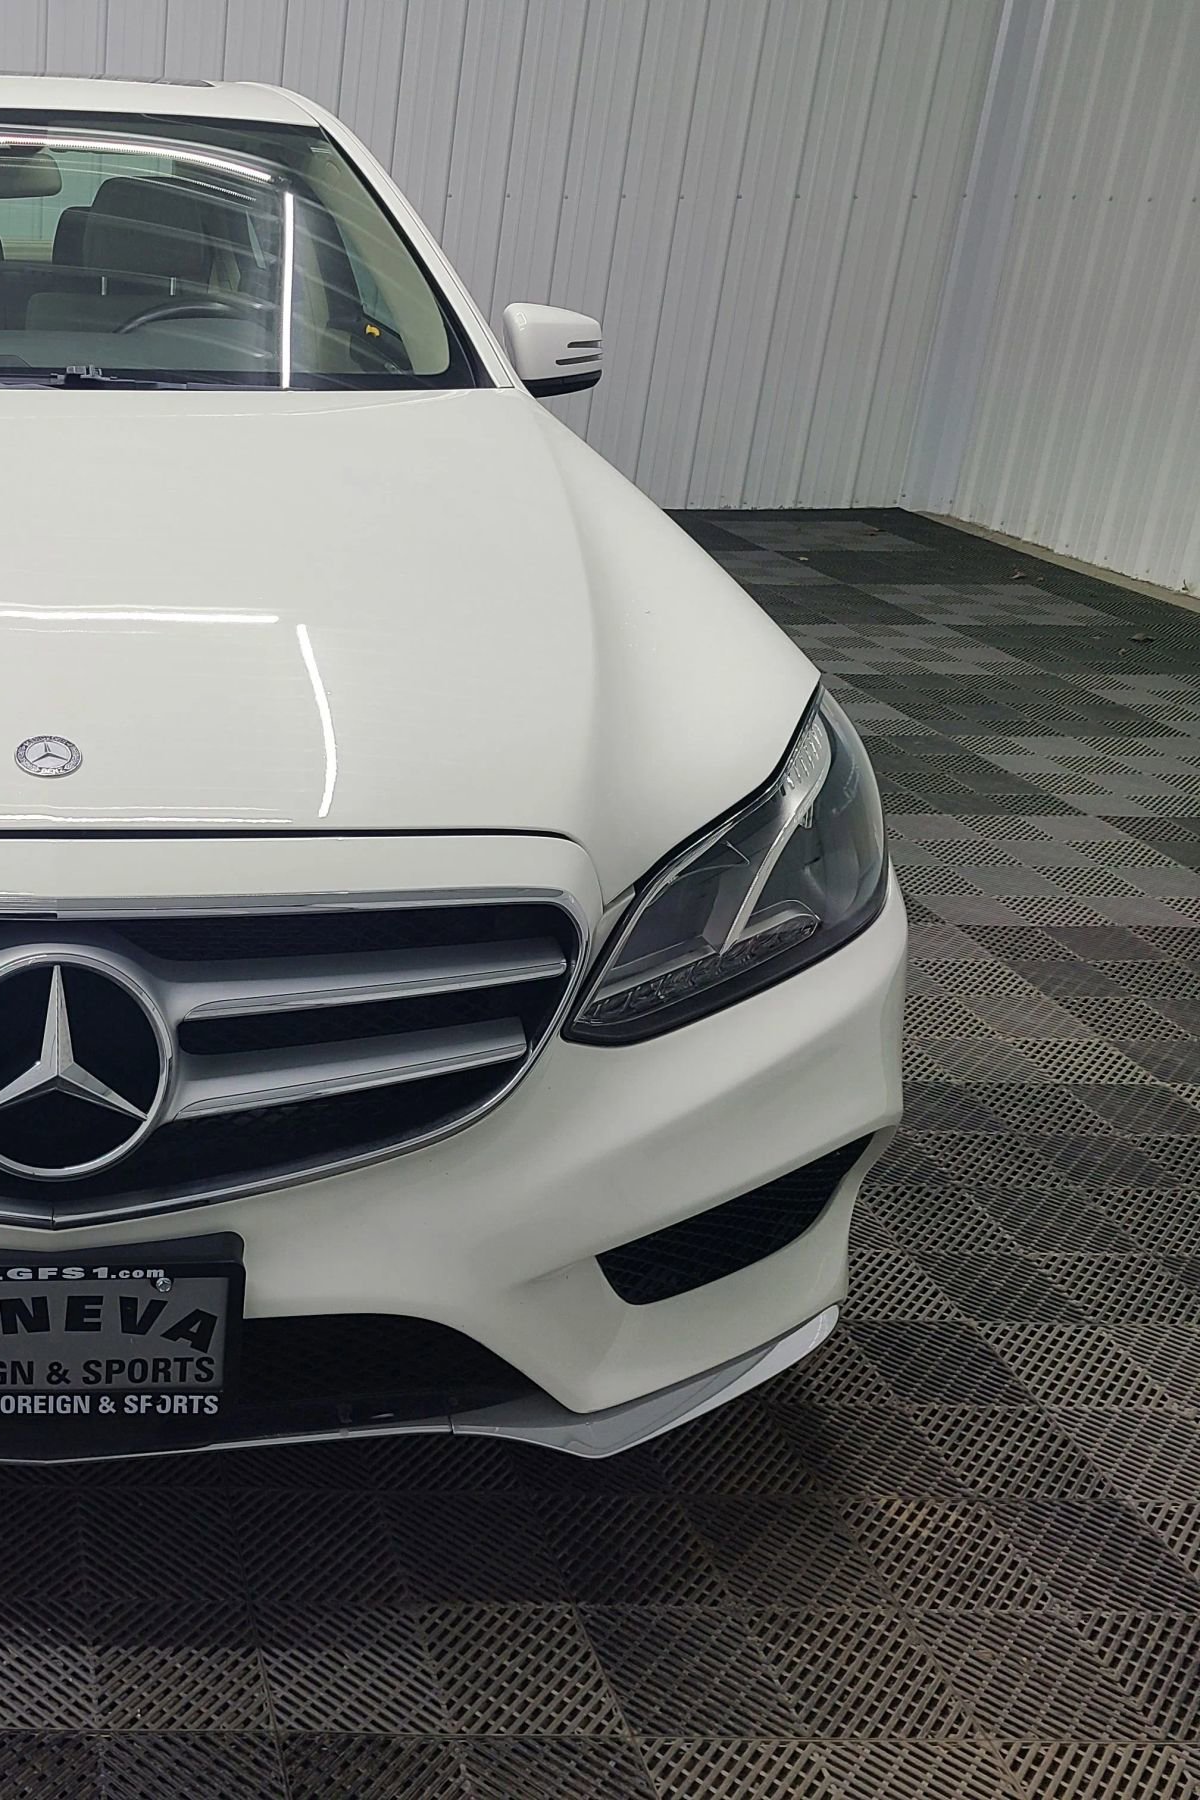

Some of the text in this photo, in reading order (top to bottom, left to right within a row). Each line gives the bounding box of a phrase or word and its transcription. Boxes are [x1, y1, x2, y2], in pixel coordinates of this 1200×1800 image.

[46, 1360, 71, 1385] &
[82, 1356, 215, 1384] SPORTS
[98, 1395, 117, 1414] &
